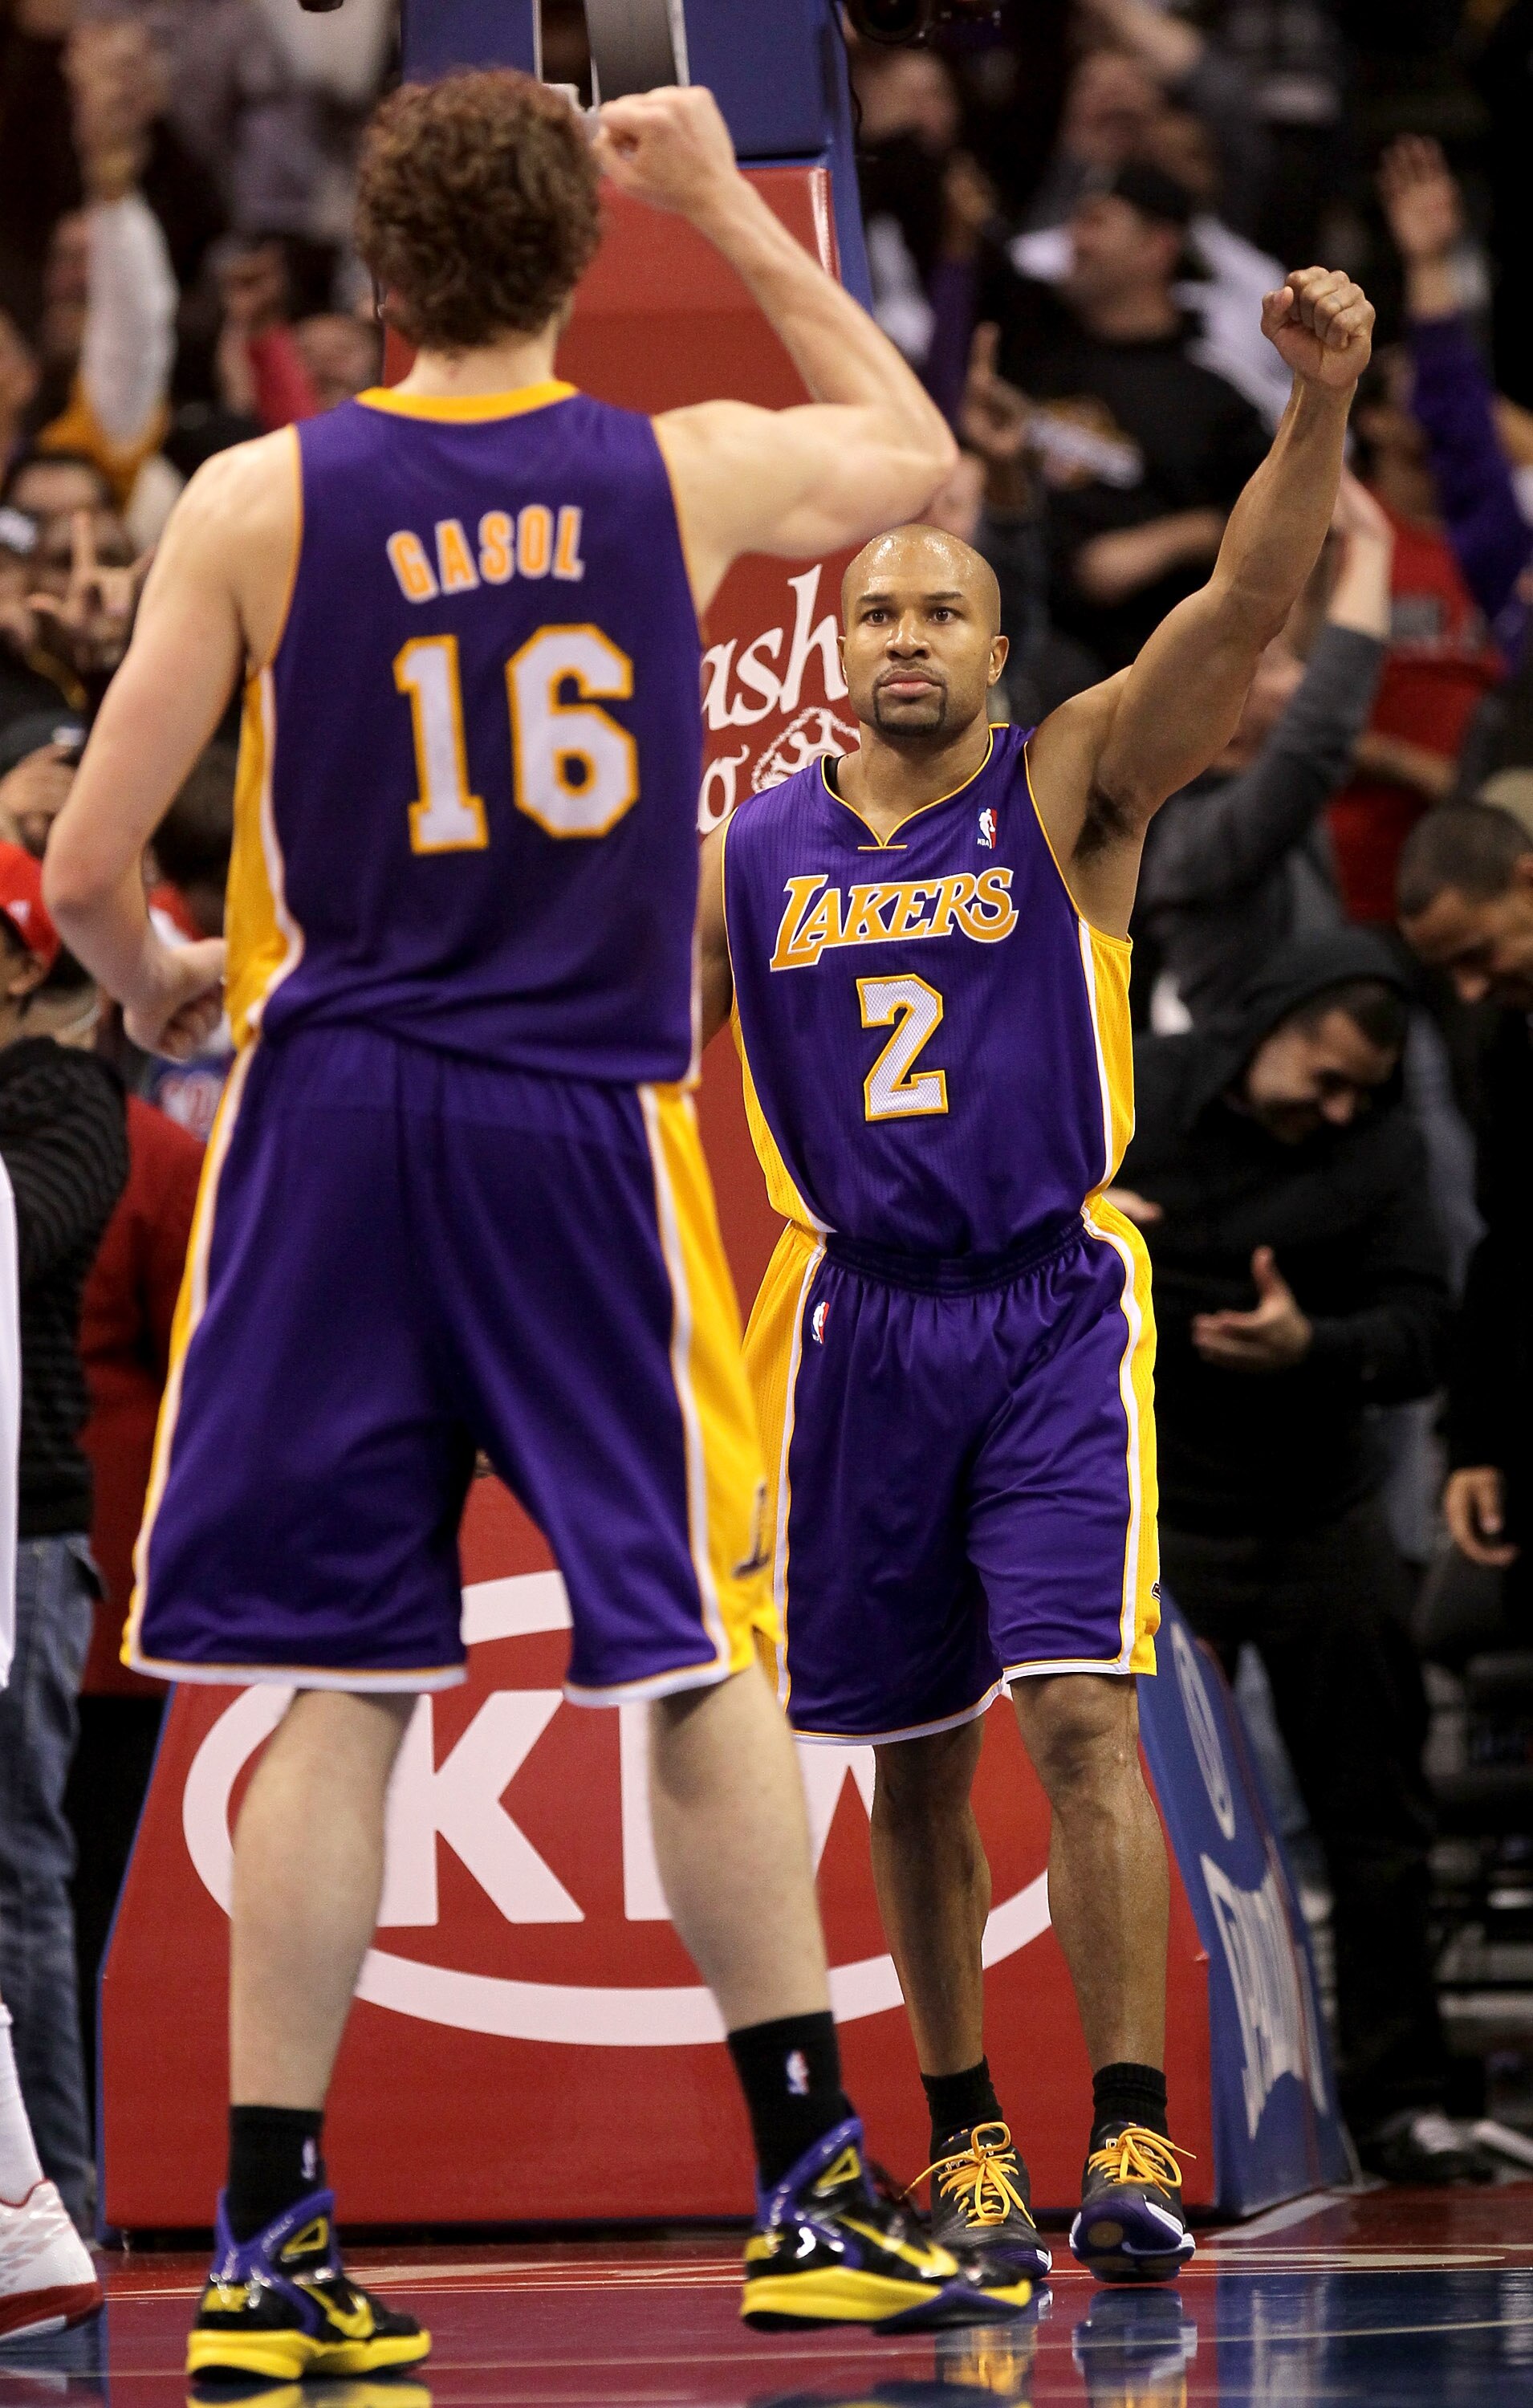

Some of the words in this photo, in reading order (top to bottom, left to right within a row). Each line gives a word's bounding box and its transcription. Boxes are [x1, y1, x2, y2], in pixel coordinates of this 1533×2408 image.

[386, 504, 586, 604] GASOL
[392, 623, 640, 856] 16
[770, 867, 1019, 972] LAKERS
[856, 974, 949, 1121] 2
